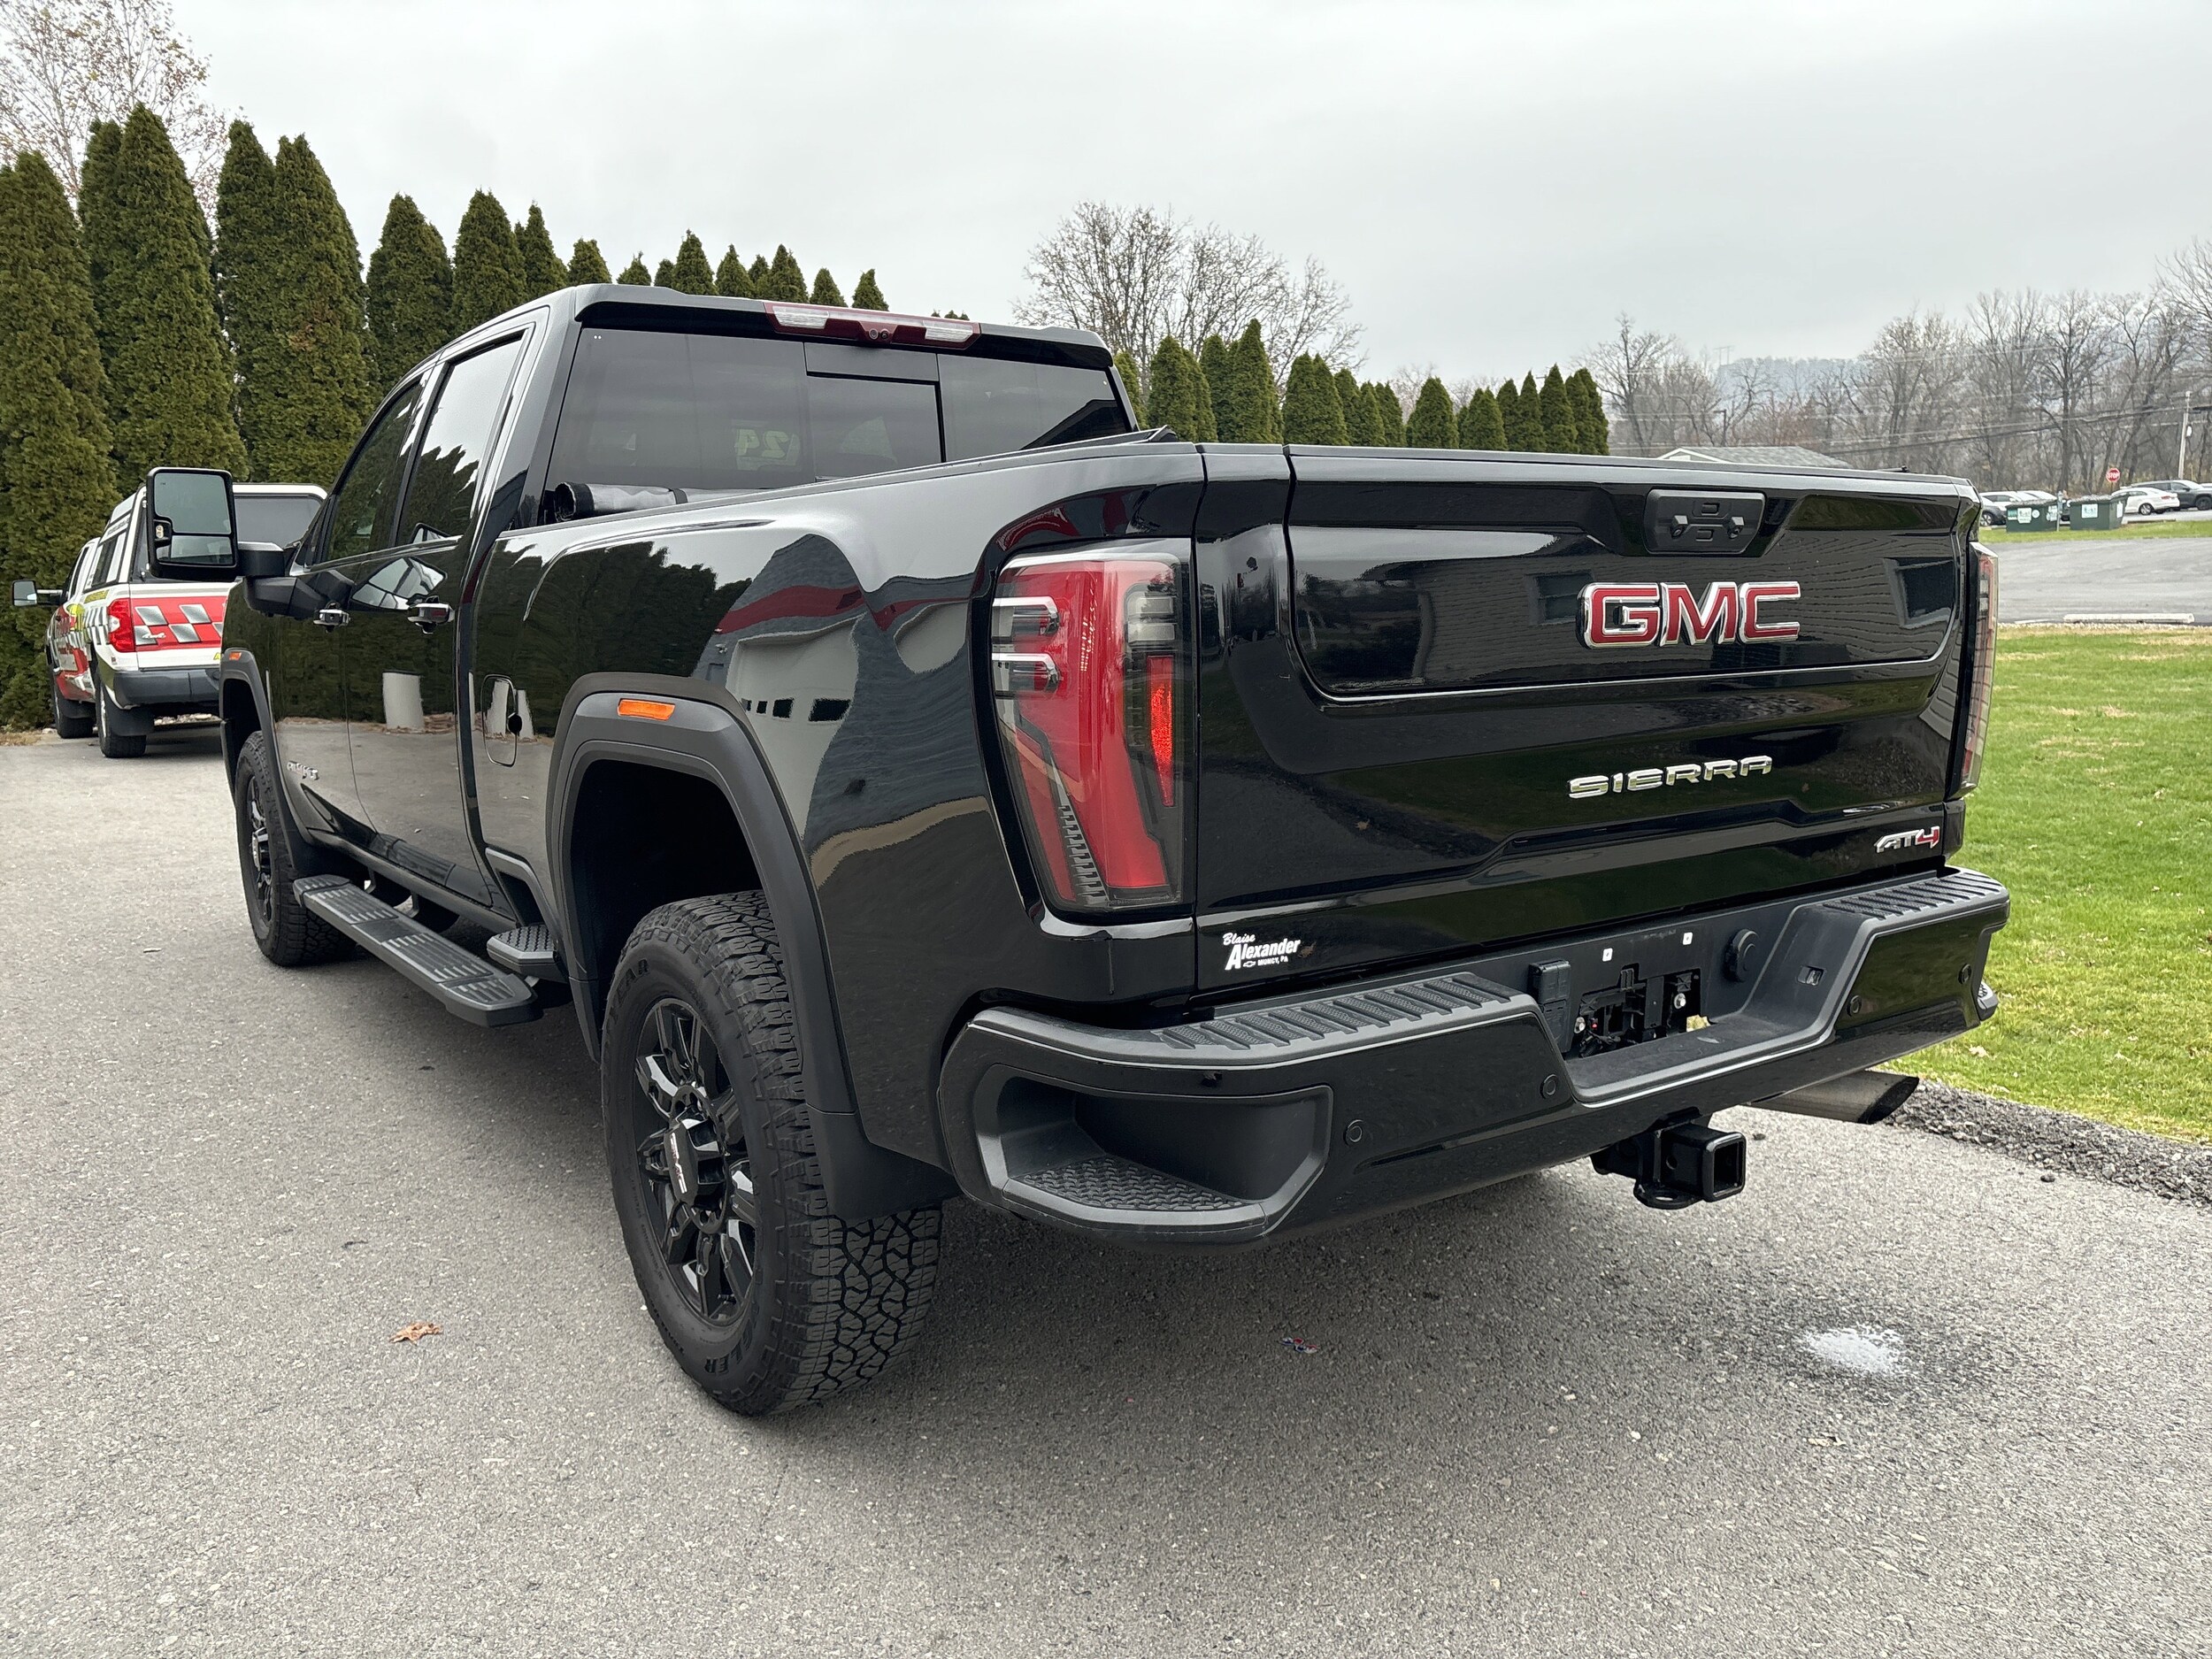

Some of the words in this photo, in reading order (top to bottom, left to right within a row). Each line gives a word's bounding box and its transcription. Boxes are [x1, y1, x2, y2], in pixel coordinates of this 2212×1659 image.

[1578, 580, 1801, 649] GMC
[1568, 755, 1773, 799] SIERRA
[1874, 826, 1940, 853] AT4
[1222, 932, 1256, 946] Blaise
[1225, 938, 1302, 971] Alexander
[1257, 956, 1279, 966] MUNCY,
